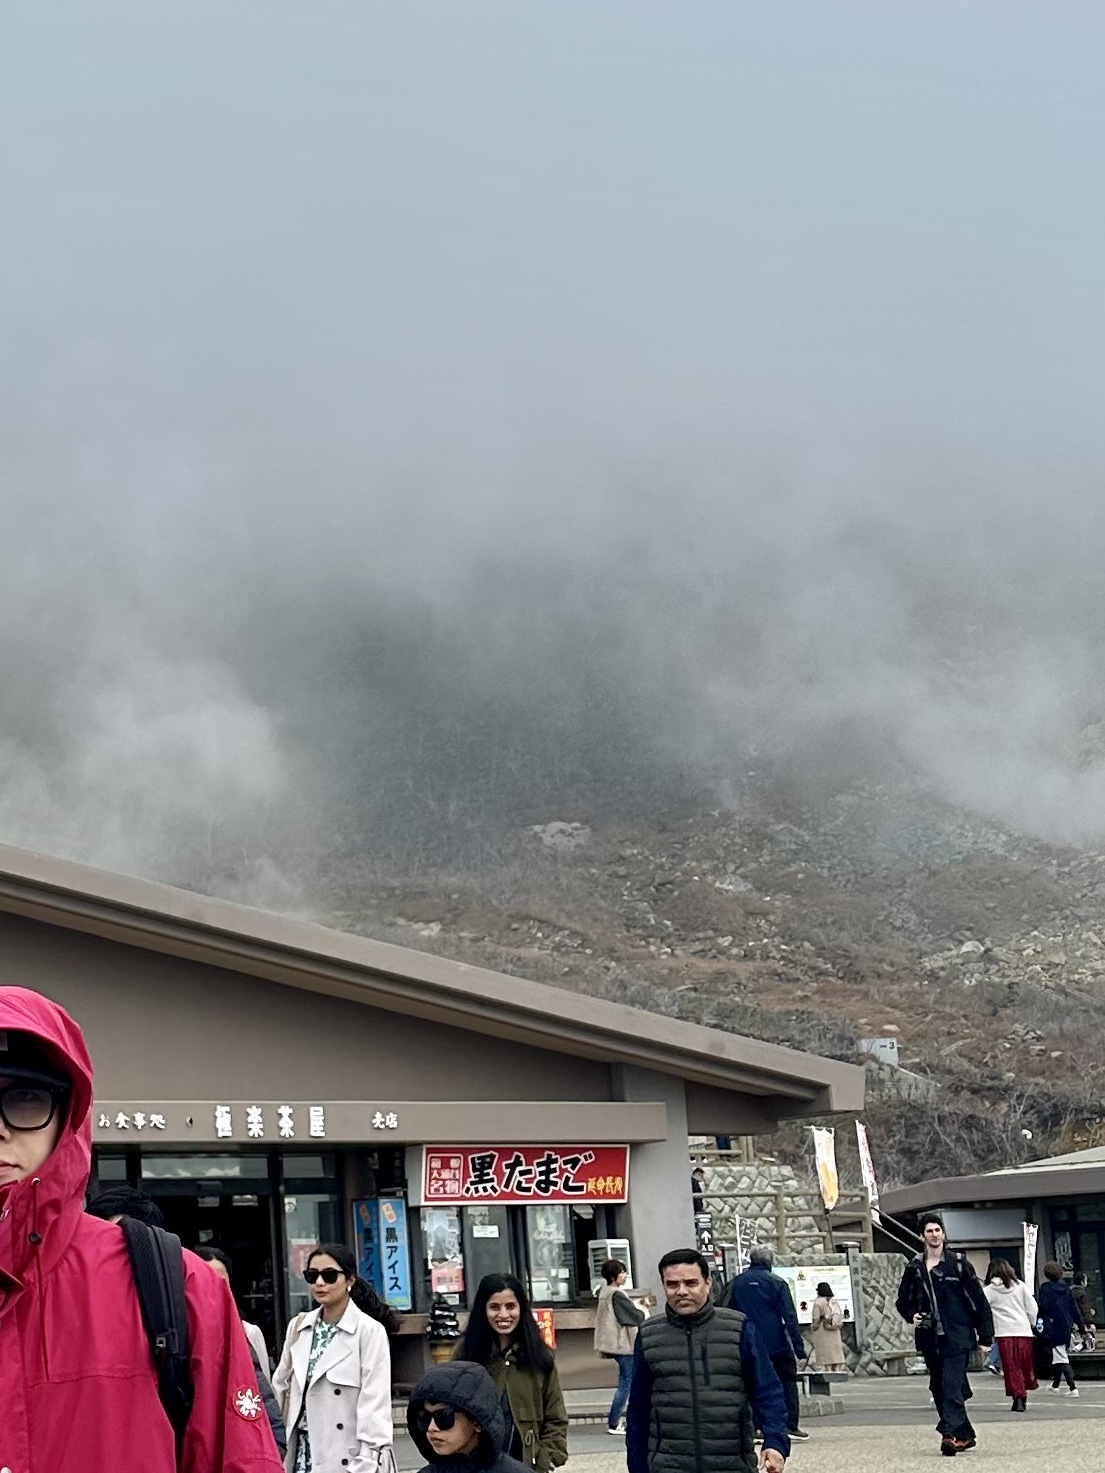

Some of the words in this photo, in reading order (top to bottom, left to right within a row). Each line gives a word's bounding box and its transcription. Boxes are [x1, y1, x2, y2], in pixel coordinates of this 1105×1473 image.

[98, 1111, 166, 1130] お食事処
[215, 1104, 326, 1138] 極楽茶屋
[371, 1111, 399, 1130] 売店
[463, 1150, 595, 1198] 黒たまご
[385, 1226, 402, 1292] 黒アイス
